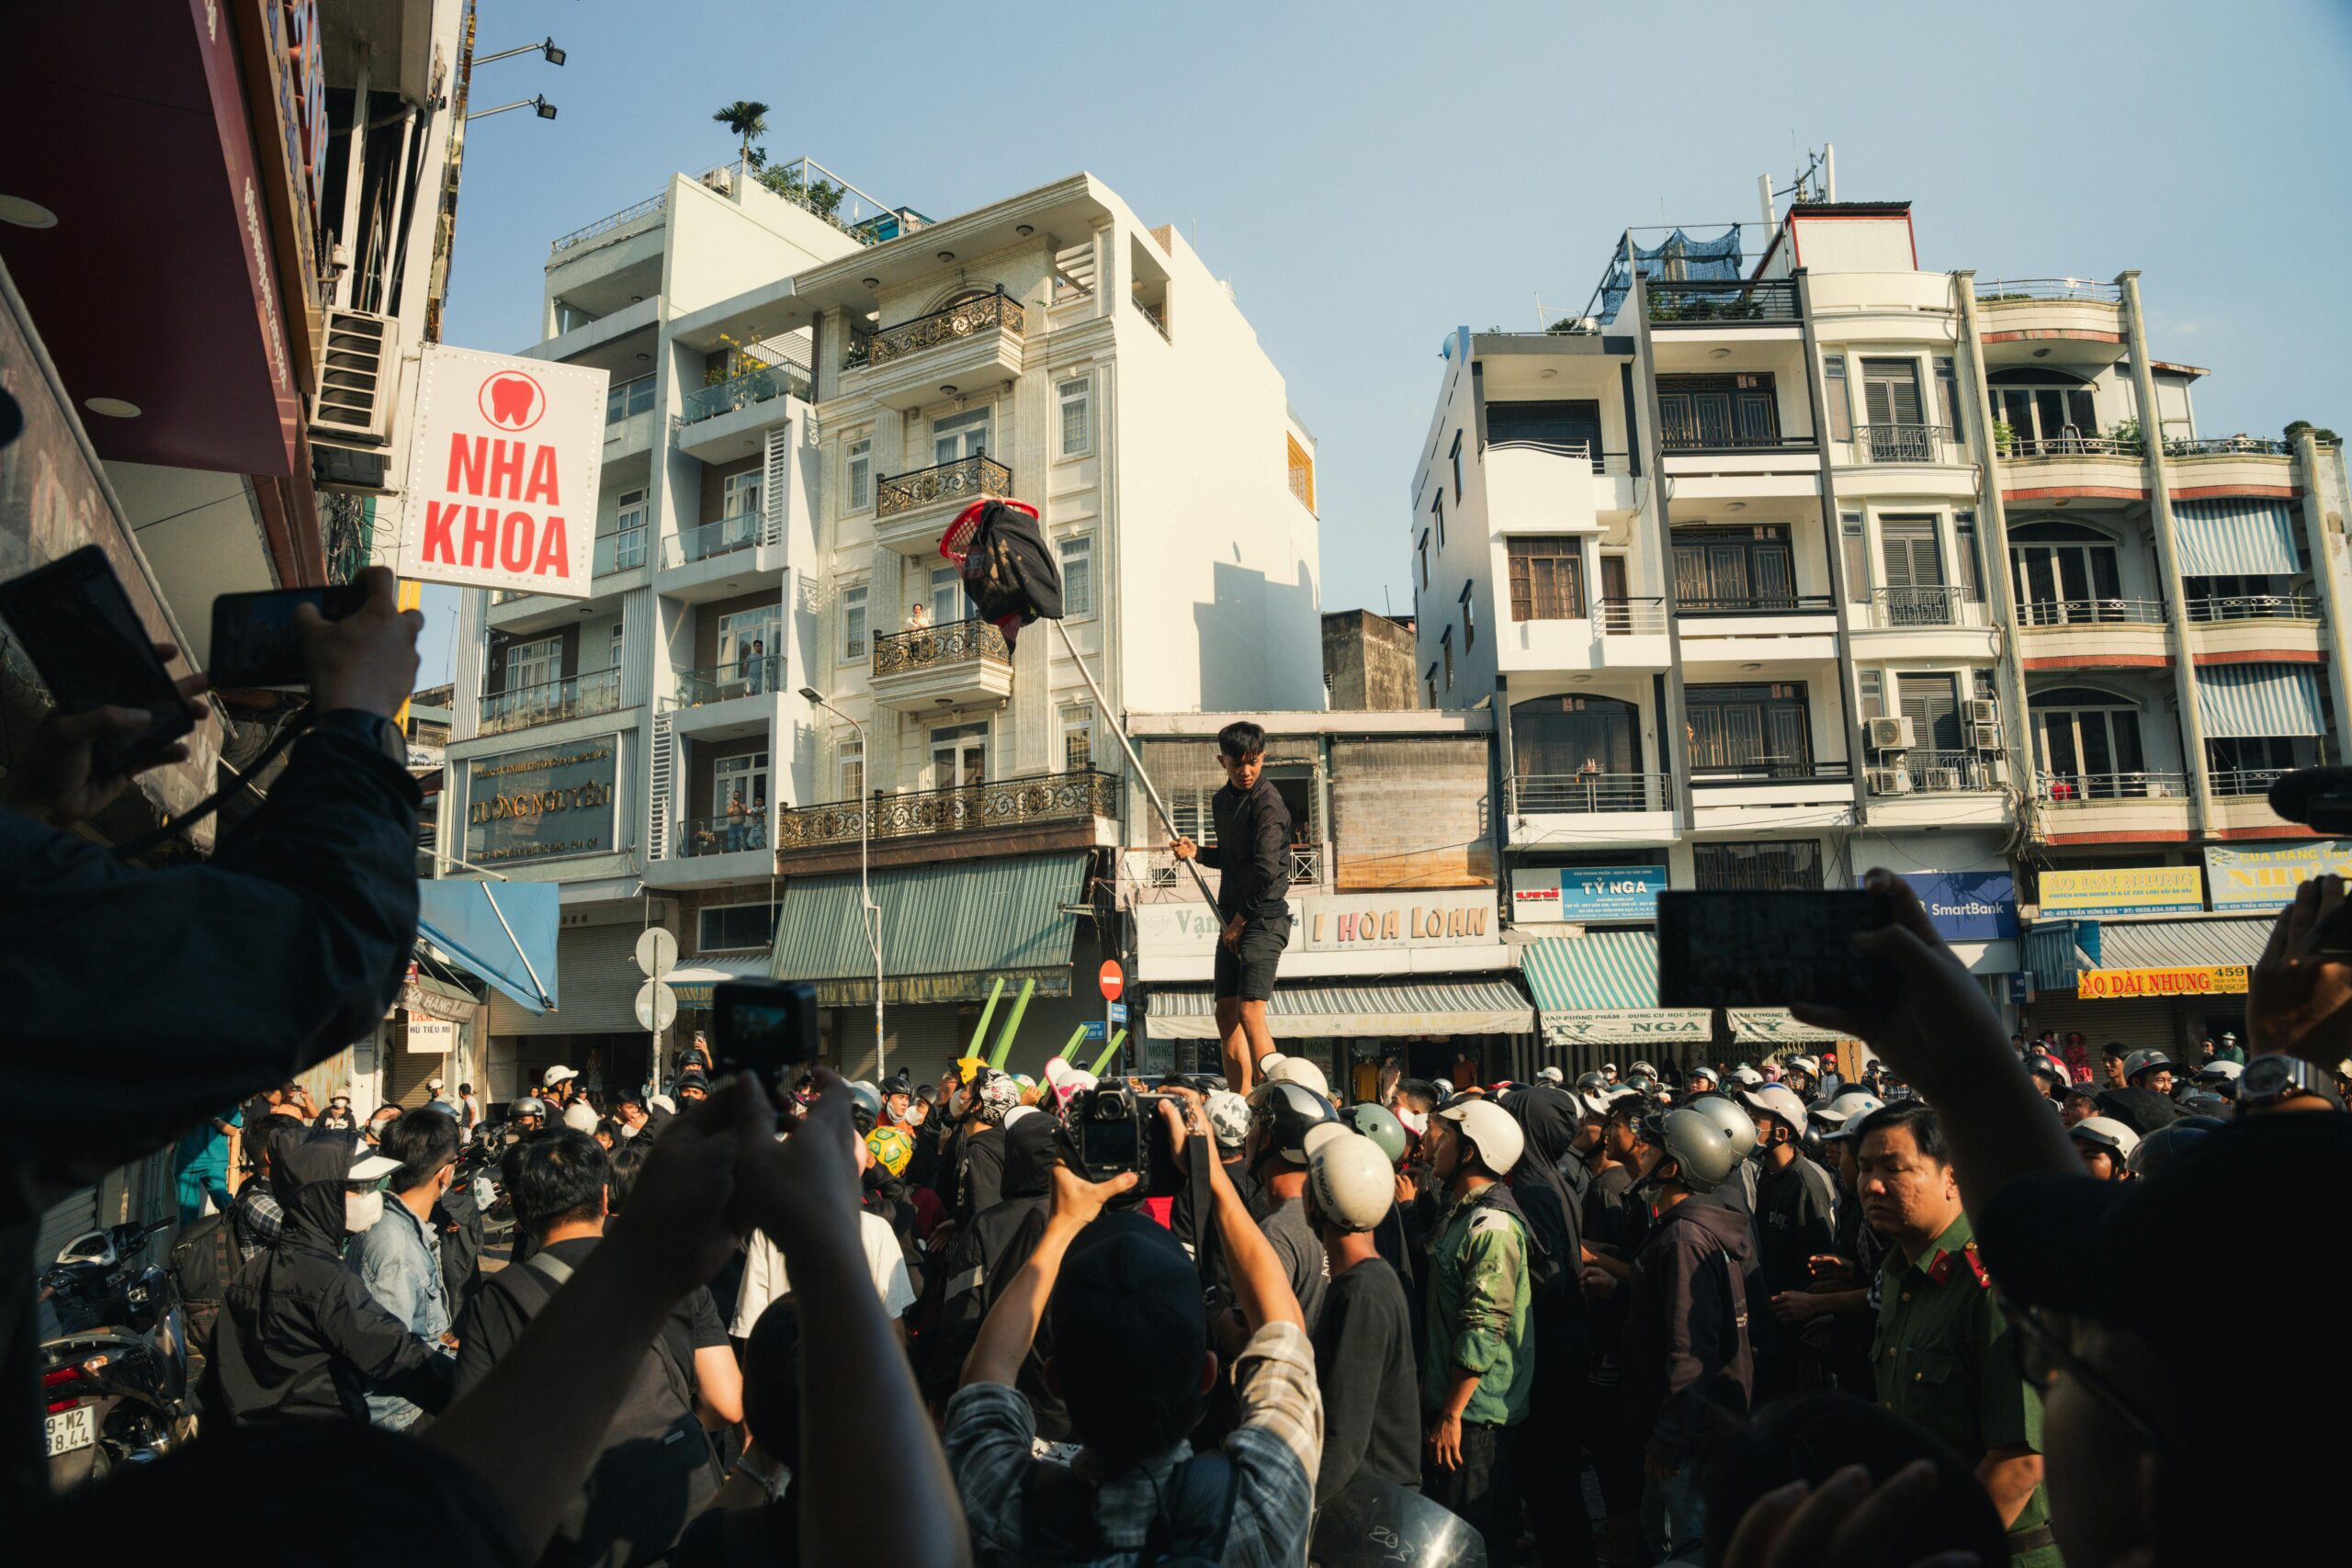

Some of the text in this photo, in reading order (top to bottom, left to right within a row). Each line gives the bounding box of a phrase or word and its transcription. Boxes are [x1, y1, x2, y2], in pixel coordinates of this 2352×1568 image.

[447, 432, 560, 506] NHA
[422, 501, 570, 579] KHOA
[1516, 887, 1559, 899] uni
[1609, 879, 1647, 895] NGA
[1931, 901, 2005, 916] SmartBank
[1338, 909, 1400, 942] HOA
[1410, 906, 1488, 939] LOAN
[2214, 967, 2245, 977] 459
[2082, 970, 2211, 995] ÁO DÀI NHUNG
[1630, 1021, 1702, 1032] NGA
[46, 1410, 85, 1435] 9-M2
